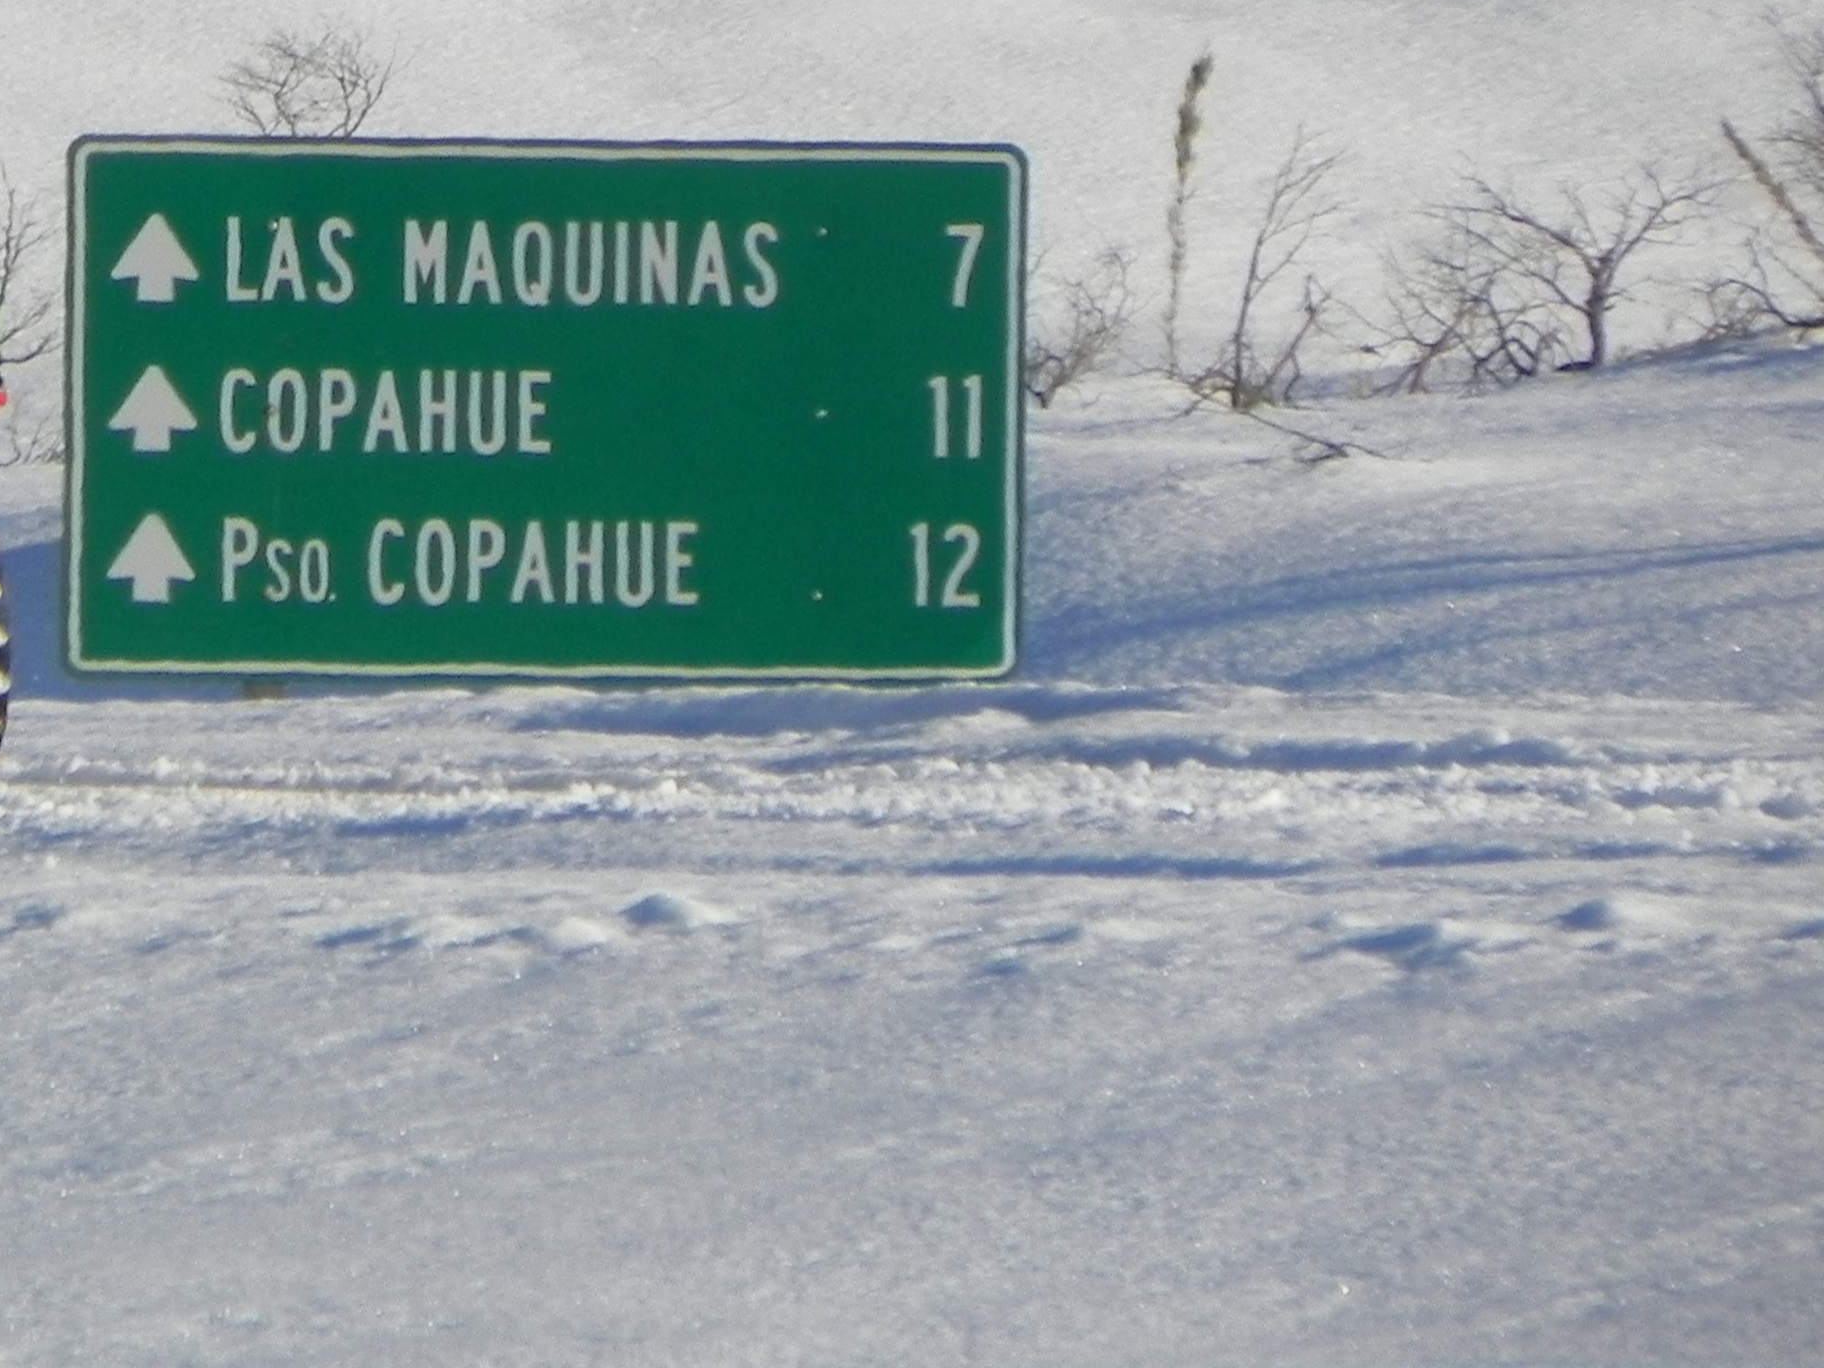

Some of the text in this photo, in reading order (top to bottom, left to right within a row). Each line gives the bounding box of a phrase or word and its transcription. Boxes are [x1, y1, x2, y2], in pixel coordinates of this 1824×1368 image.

[226, 216, 984, 308] LAS MAQUINAS 7
[219, 368, 983, 459] COPAHUE 11
[368, 518, 700, 608] COPAHUE
[910, 522, 981, 608] 12
